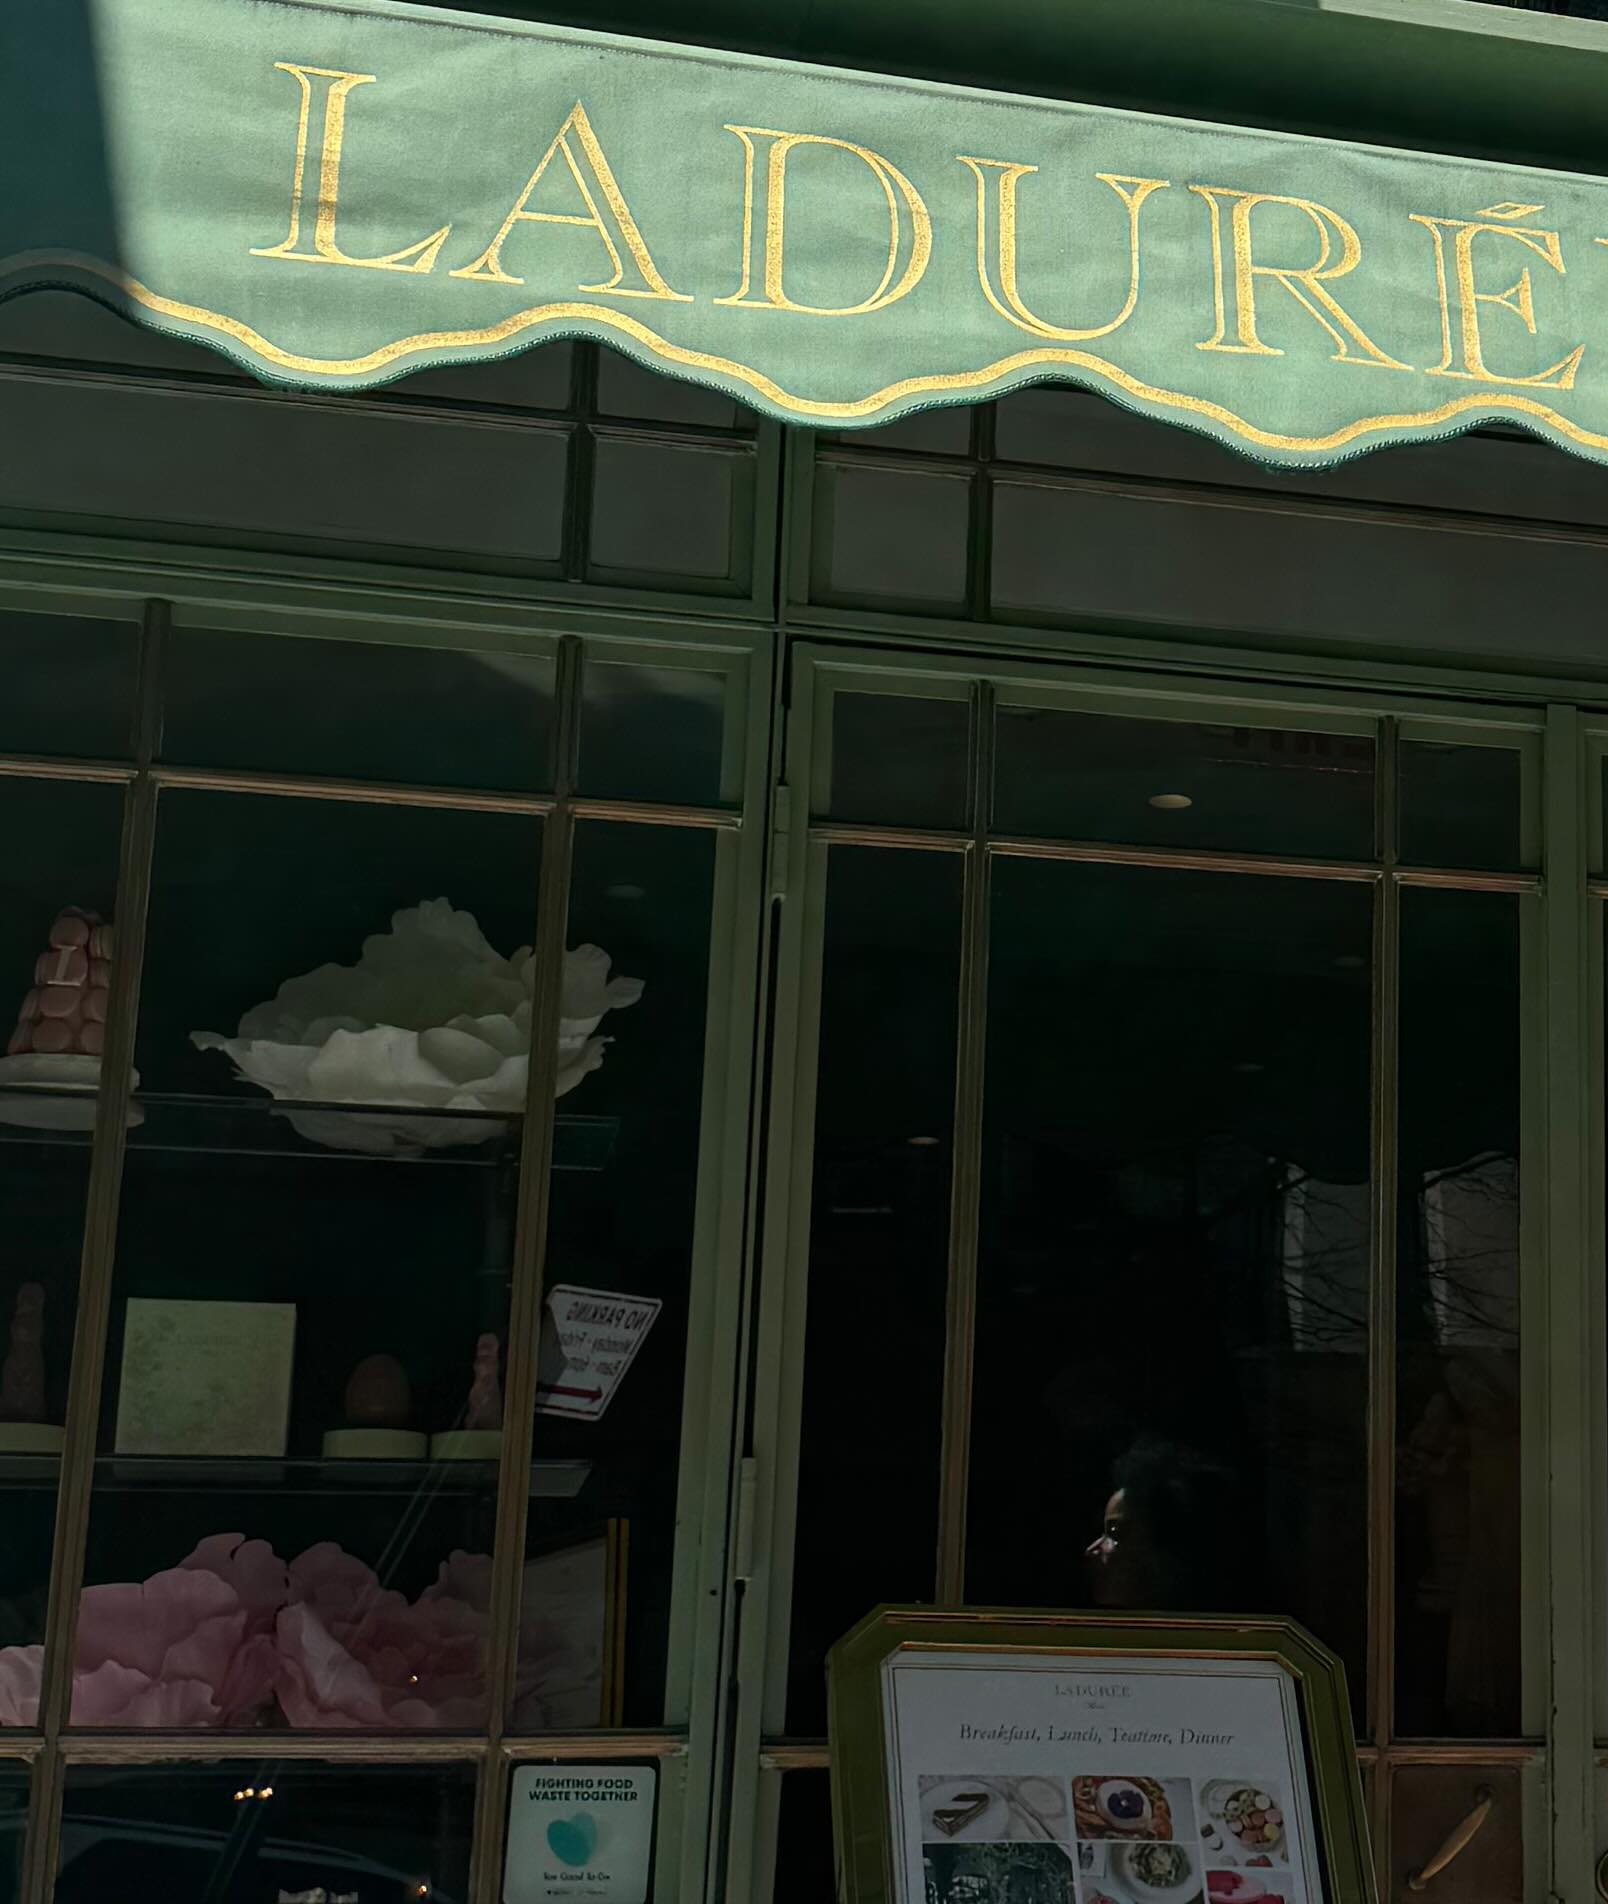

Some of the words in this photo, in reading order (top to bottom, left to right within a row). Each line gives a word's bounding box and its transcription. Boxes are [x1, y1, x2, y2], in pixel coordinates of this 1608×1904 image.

[959, 1723, 1041, 1746] Breakfast,
[1048, 1724, 1102, 1744] Lunch,
[1180, 1728, 1236, 1745] Dinner
[535, 1778, 594, 1789] FIGHTING
[597, 1779, 633, 1789] FOOD
[528, 1791, 571, 1801] WASTE
[576, 1791, 638, 1801] TOGETHER
